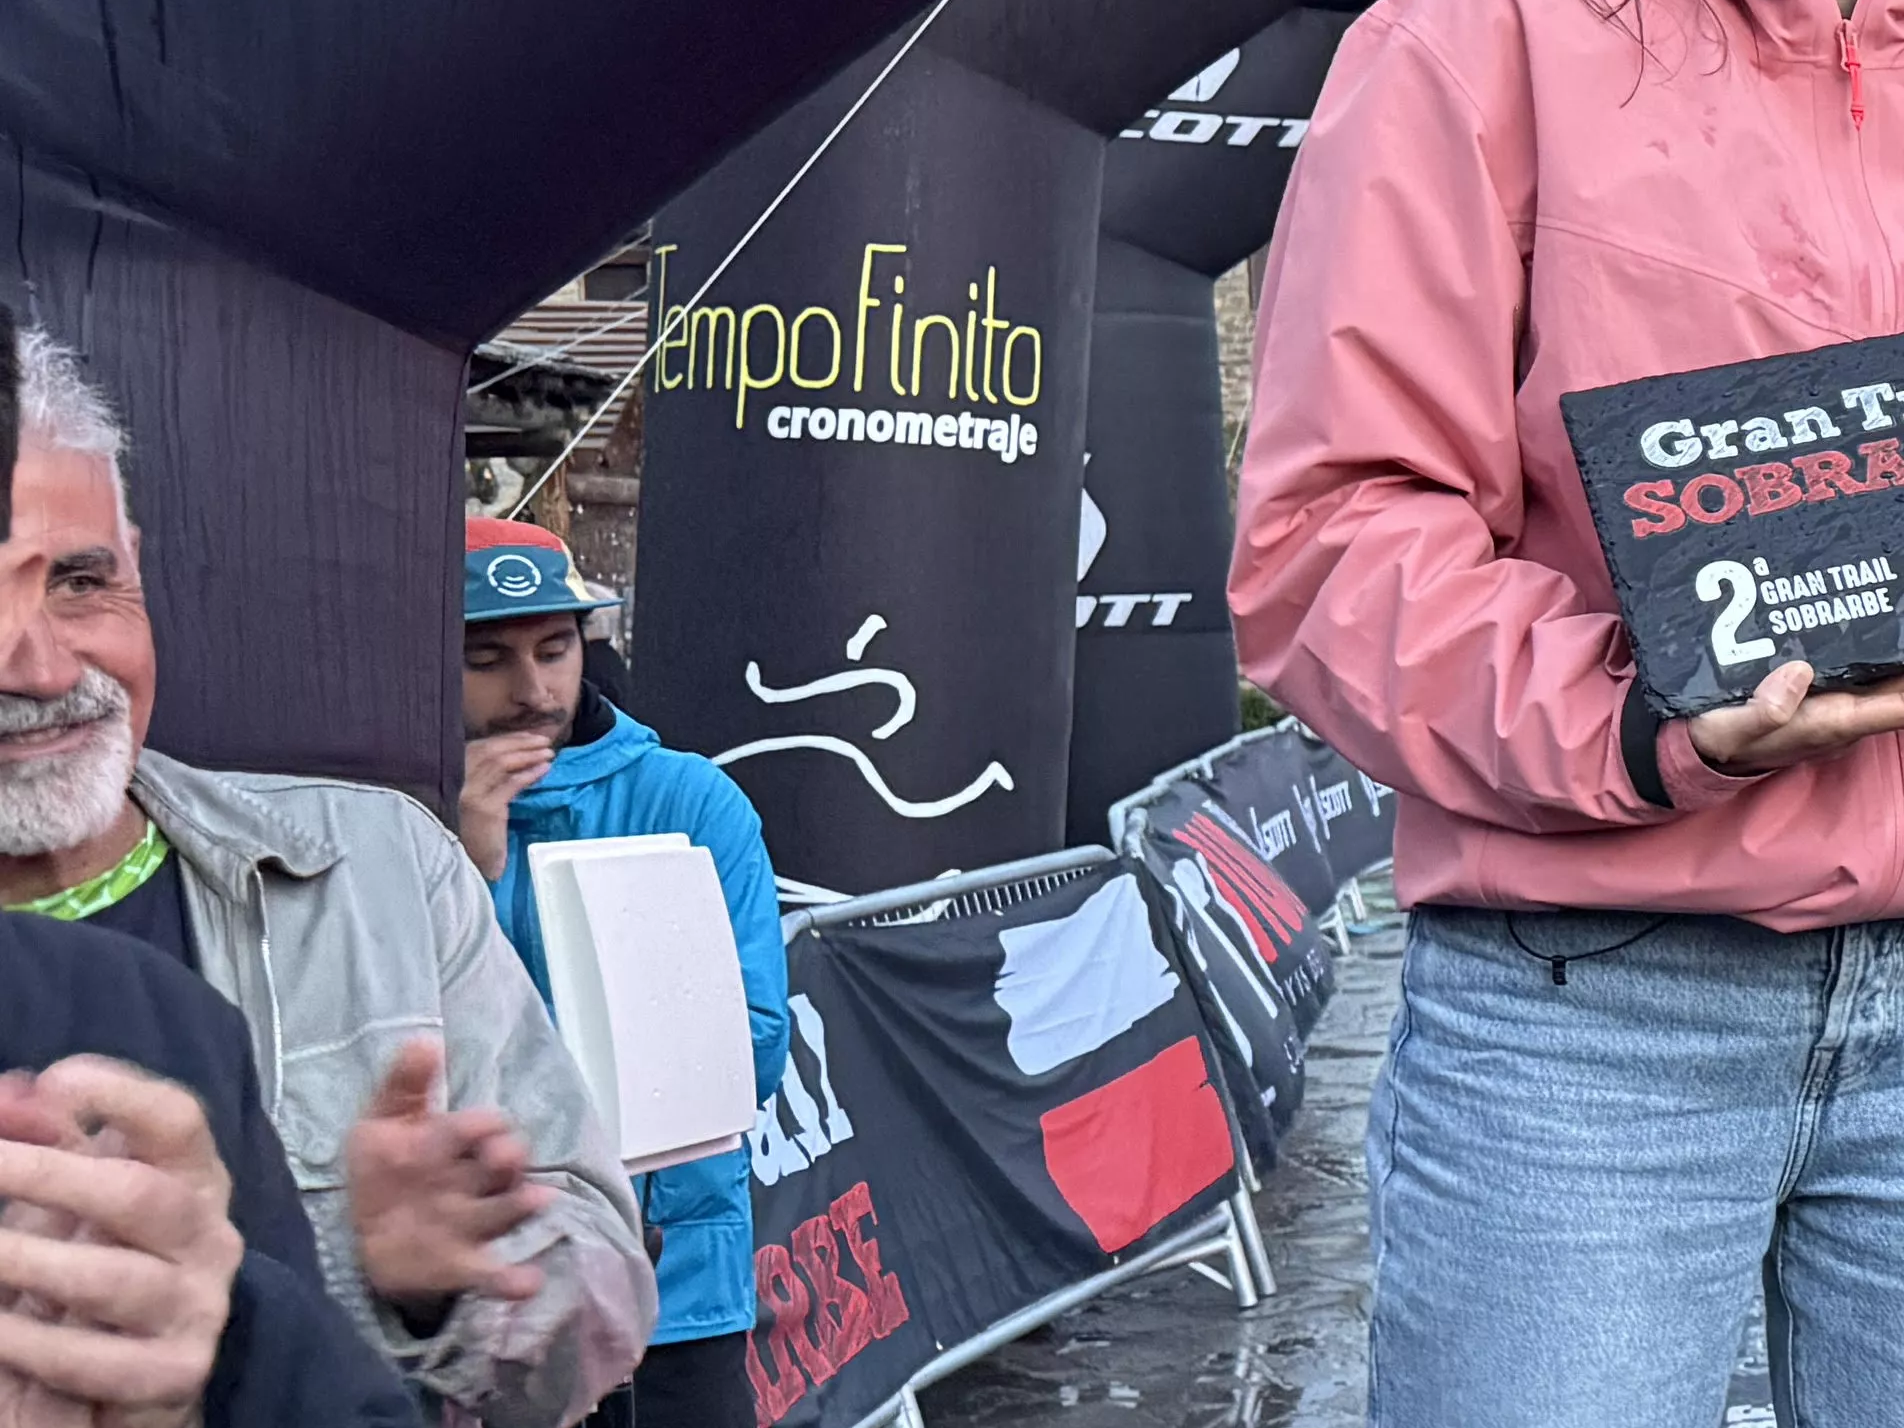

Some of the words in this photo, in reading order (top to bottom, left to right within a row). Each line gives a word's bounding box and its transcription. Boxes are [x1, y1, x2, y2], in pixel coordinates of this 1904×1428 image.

[767, 405, 1038, 464] cronometraje
[1640, 405, 1840, 468] Gran
[1760, 570, 1827, 605] GRAN
[1827, 556, 1898, 590] TRAIL
[1768, 587, 1894, 635] SOBRARBE
